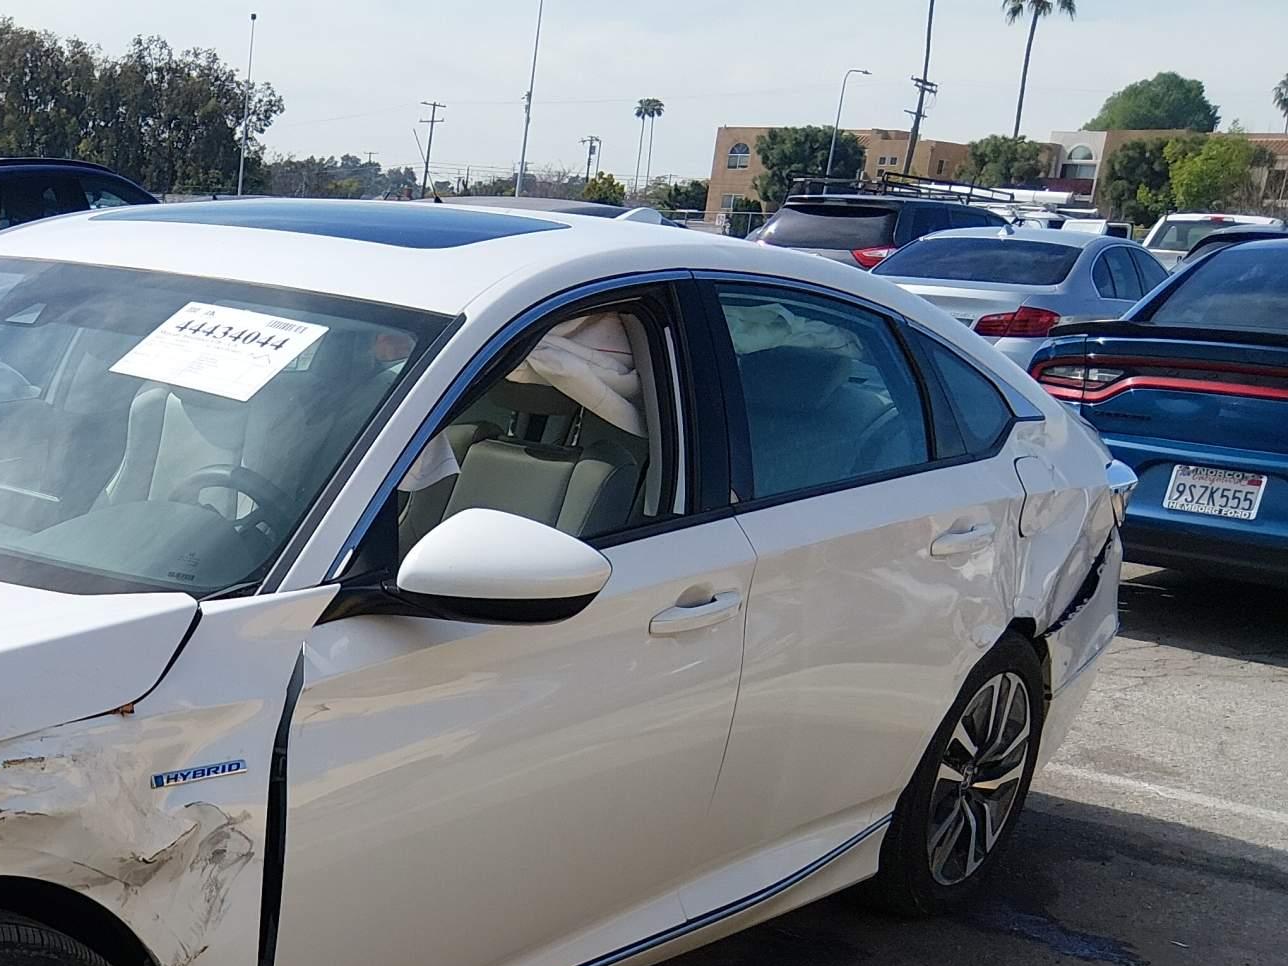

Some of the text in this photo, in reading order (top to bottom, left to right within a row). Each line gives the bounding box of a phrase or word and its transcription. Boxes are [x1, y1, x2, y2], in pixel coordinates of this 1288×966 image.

[175, 319, 290, 351] 44434044
[1173, 482, 1254, 511] 9SZK555
[1222, 508, 1250, 519] FORD
[166, 762, 241, 784] HYBRID
